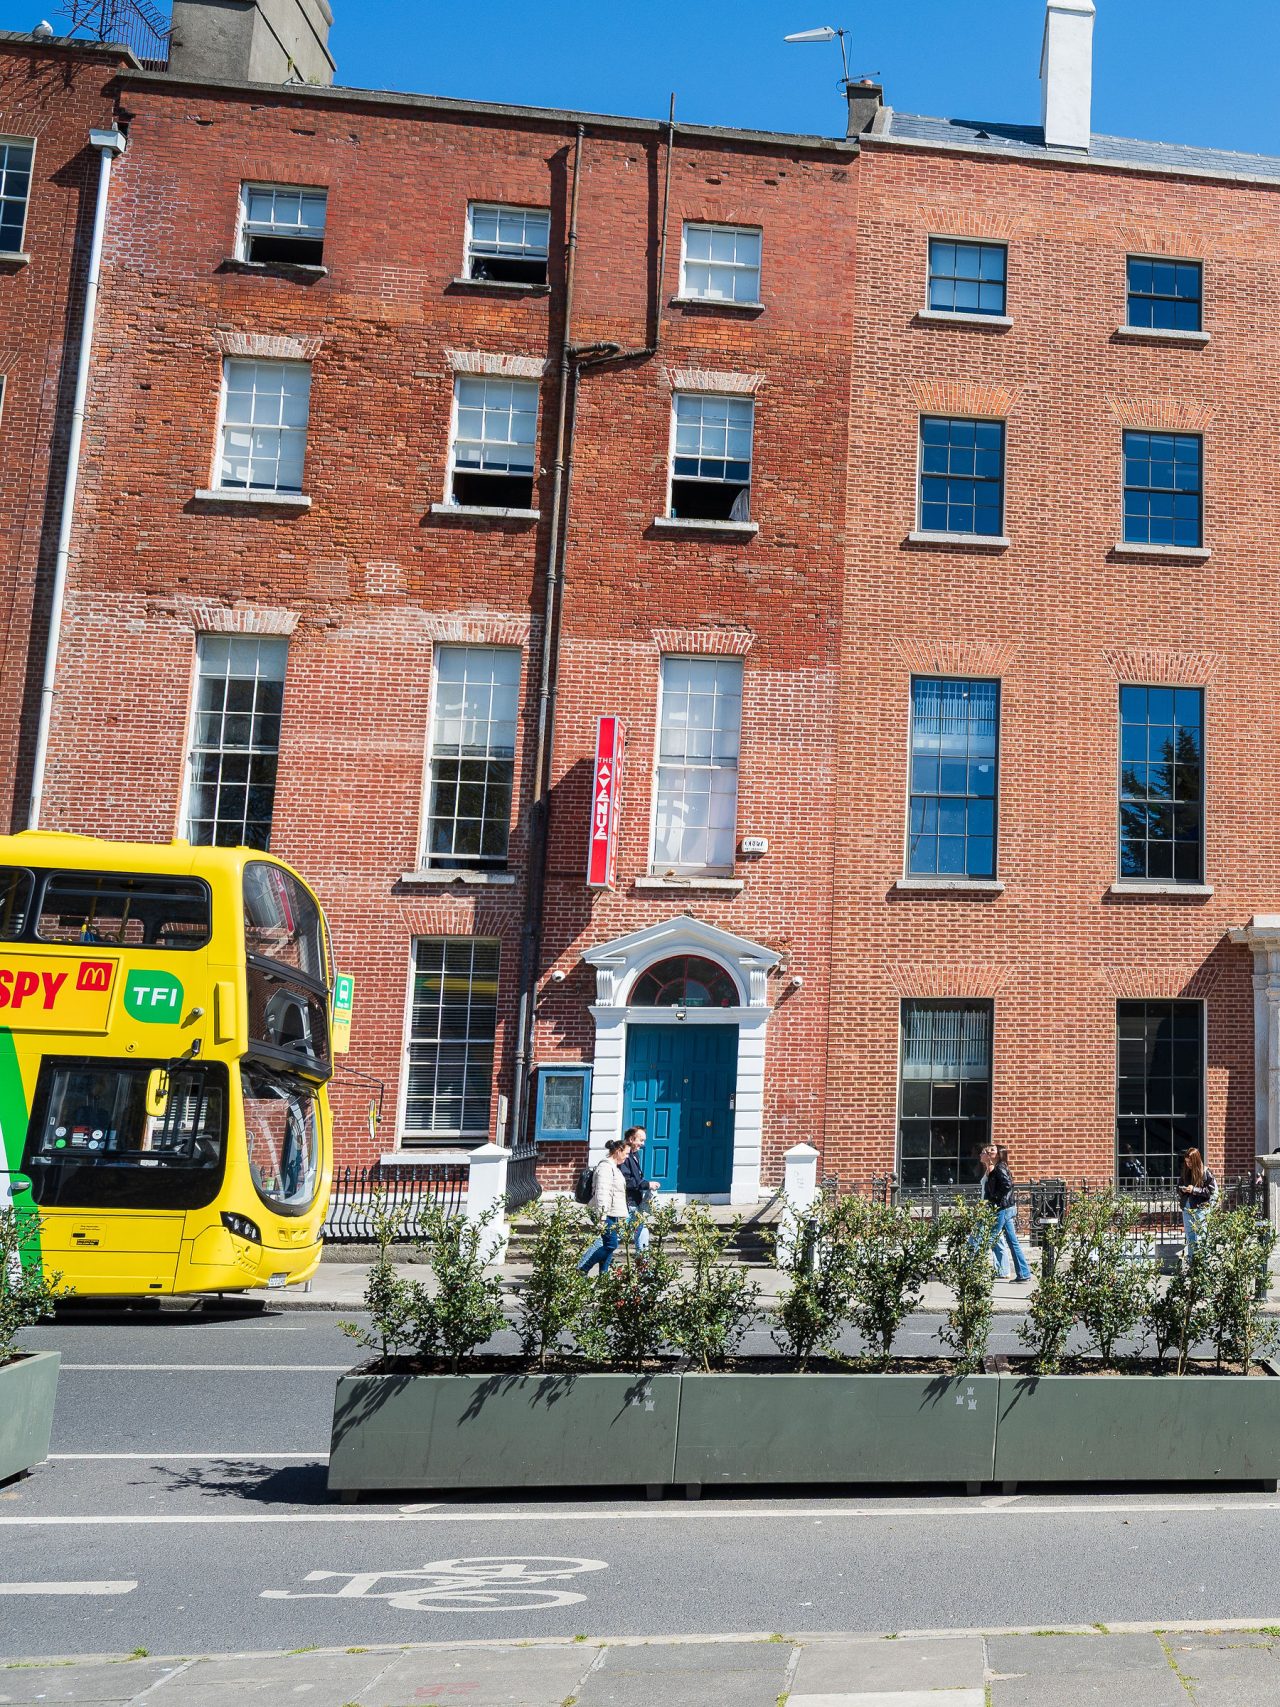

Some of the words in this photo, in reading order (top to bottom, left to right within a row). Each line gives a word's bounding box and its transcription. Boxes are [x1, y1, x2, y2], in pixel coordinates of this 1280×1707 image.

[593, 764, 611, 840] AVENUE
[0, 969, 69, 1010] SPY
[133, 986, 178, 1007] TFI
